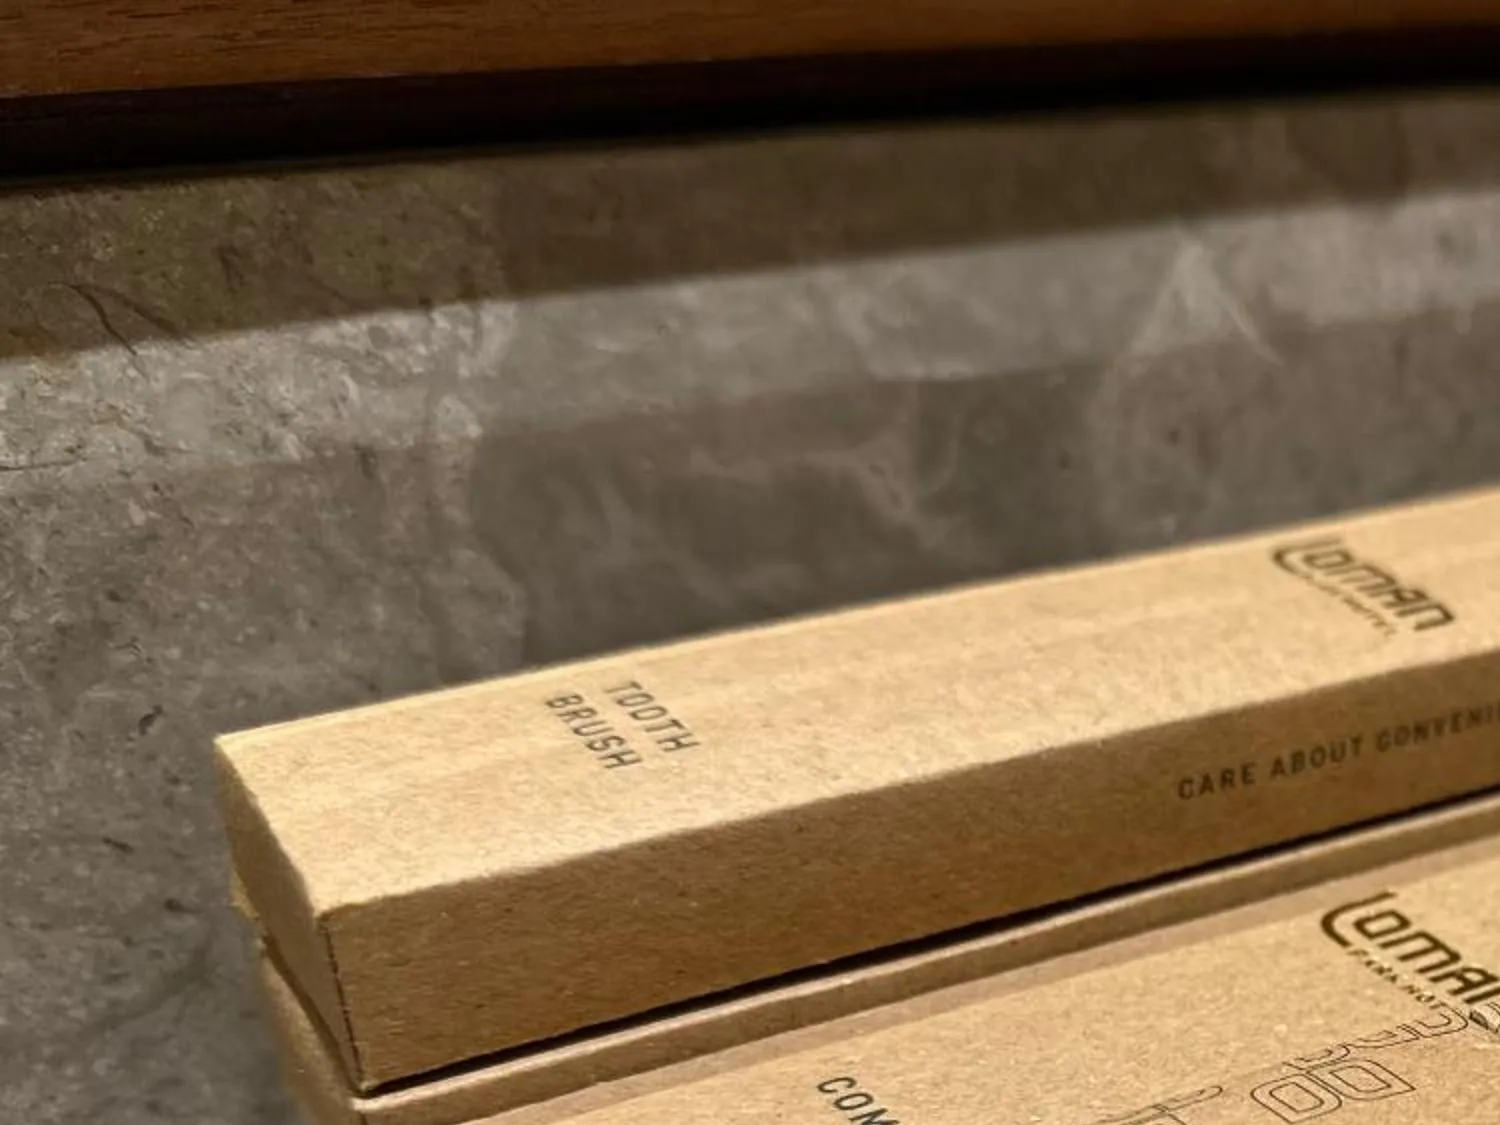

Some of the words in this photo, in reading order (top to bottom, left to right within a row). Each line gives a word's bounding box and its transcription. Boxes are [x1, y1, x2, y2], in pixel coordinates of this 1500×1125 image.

[545, 693, 643, 769] BRUSH
[604, 680, 701, 752] TOOTH
[1177, 762, 1257, 801] CARE
[1269, 737, 1365, 780] ABOUT
